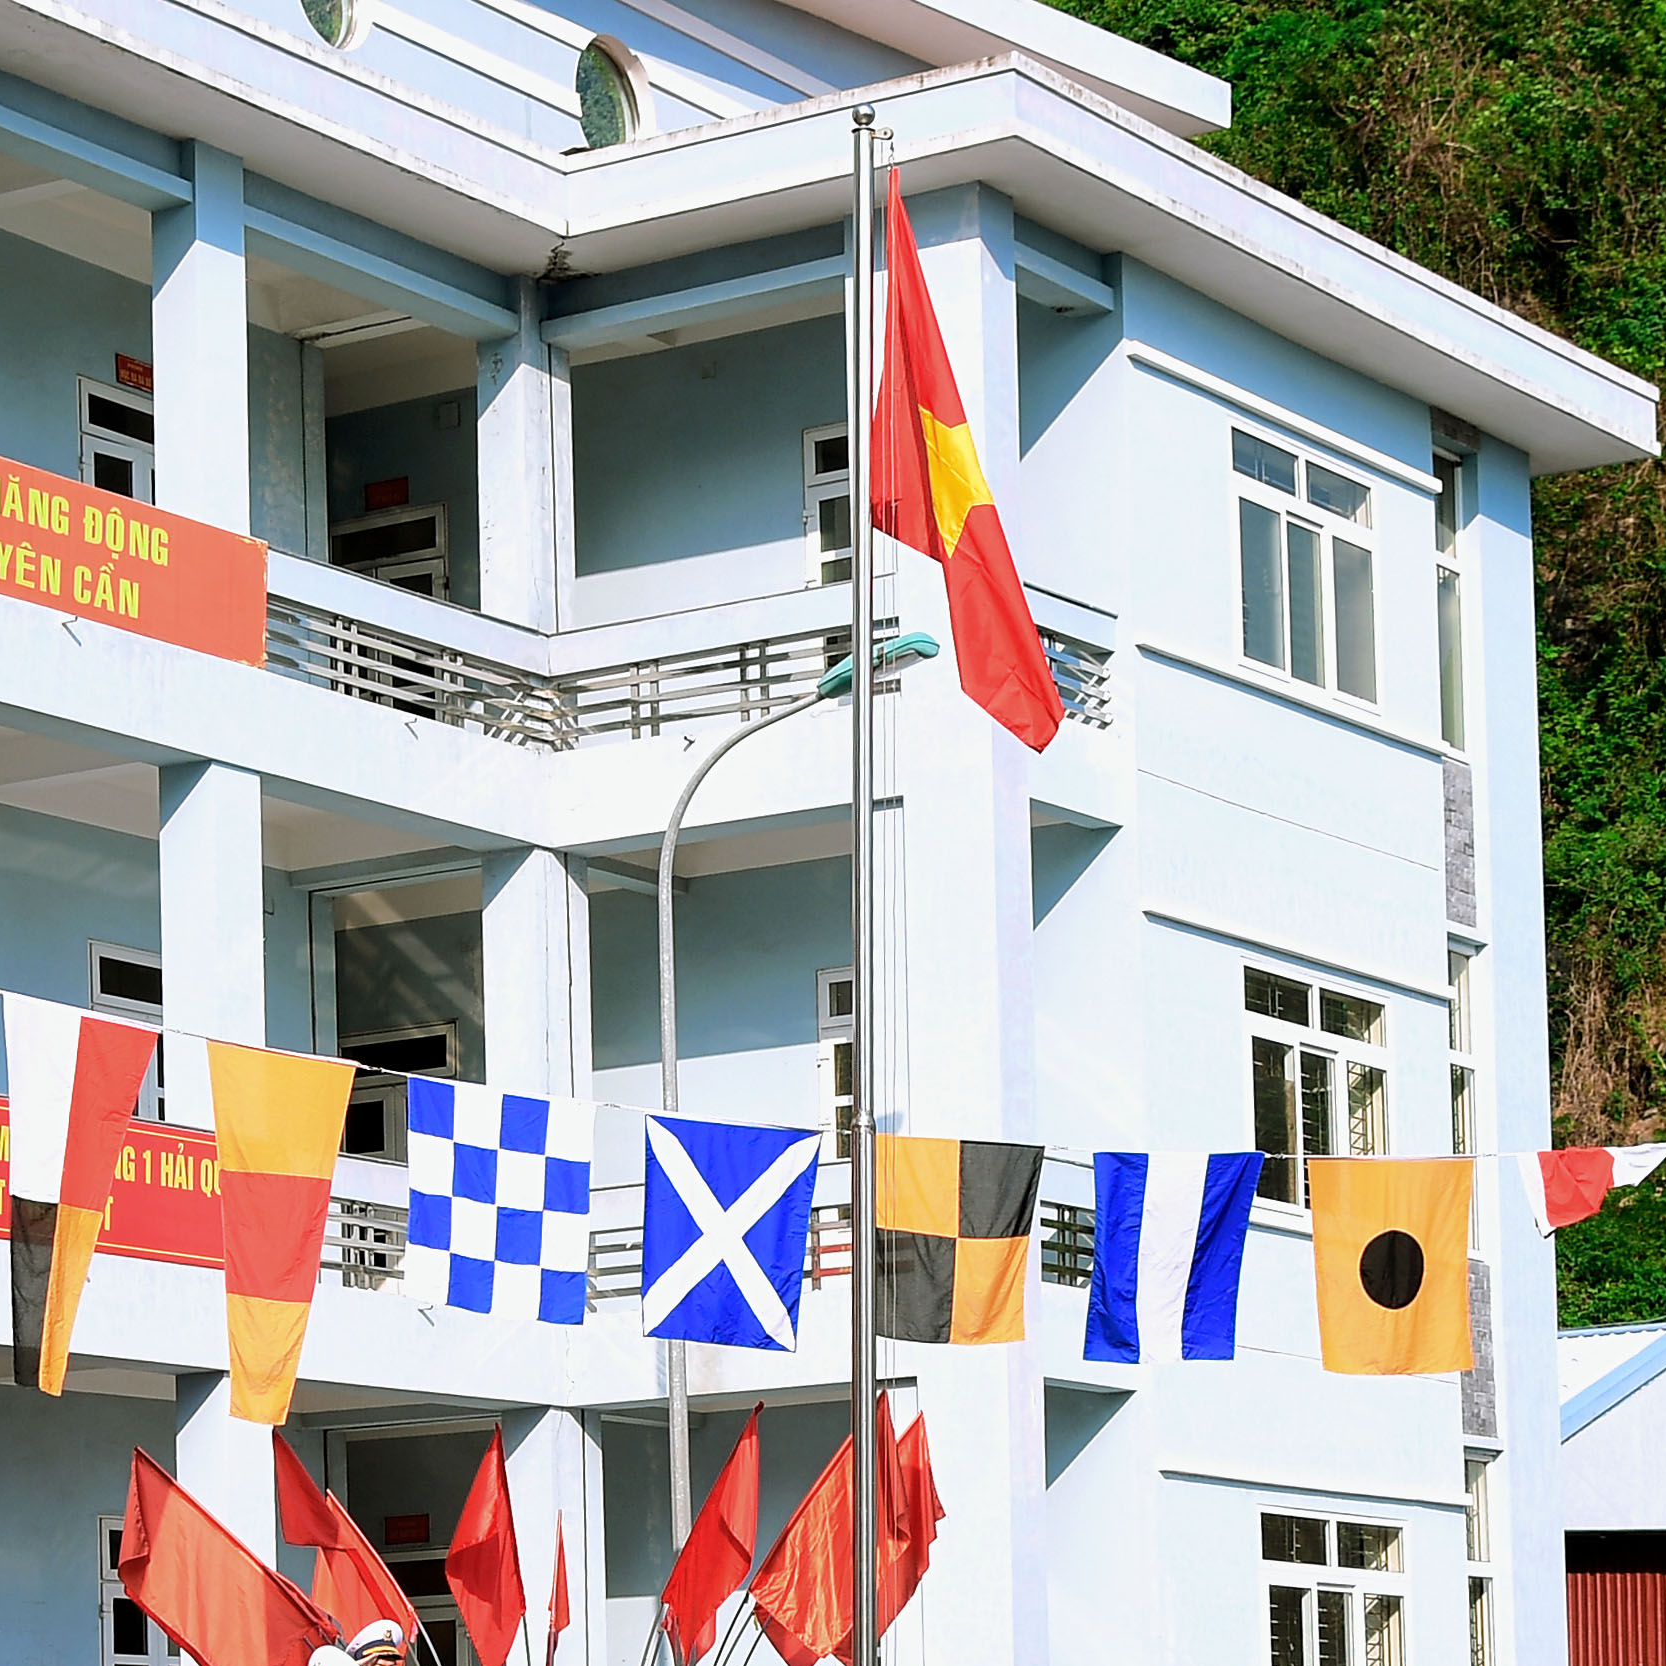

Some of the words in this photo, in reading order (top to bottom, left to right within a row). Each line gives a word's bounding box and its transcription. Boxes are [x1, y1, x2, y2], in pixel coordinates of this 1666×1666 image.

[83, 504, 169, 567] ĐỘNG
[73, 562, 140, 619] CẦN
[142, 1150, 152, 1184] 1
[160, 1142, 194, 1191] HẢI
